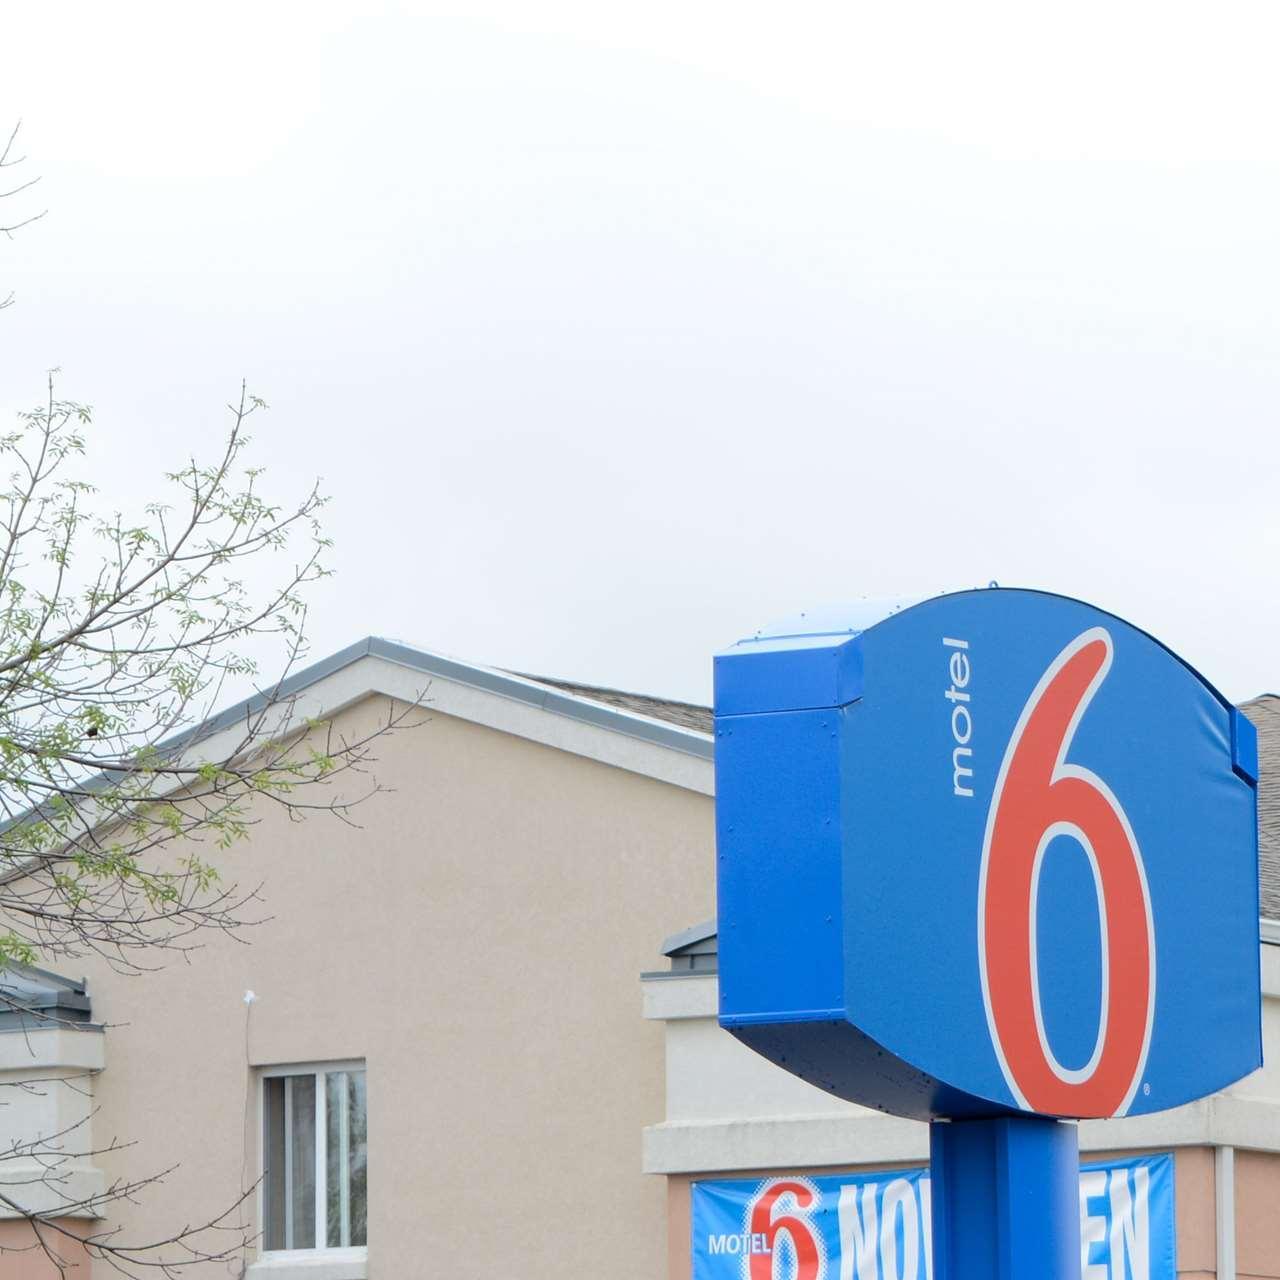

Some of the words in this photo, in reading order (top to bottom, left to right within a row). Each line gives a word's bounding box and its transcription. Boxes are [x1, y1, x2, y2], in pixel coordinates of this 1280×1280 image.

[943, 637, 974, 797] motel
[977, 627, 1156, 1119] 6
[708, 1233, 772, 1255] MOTEL
